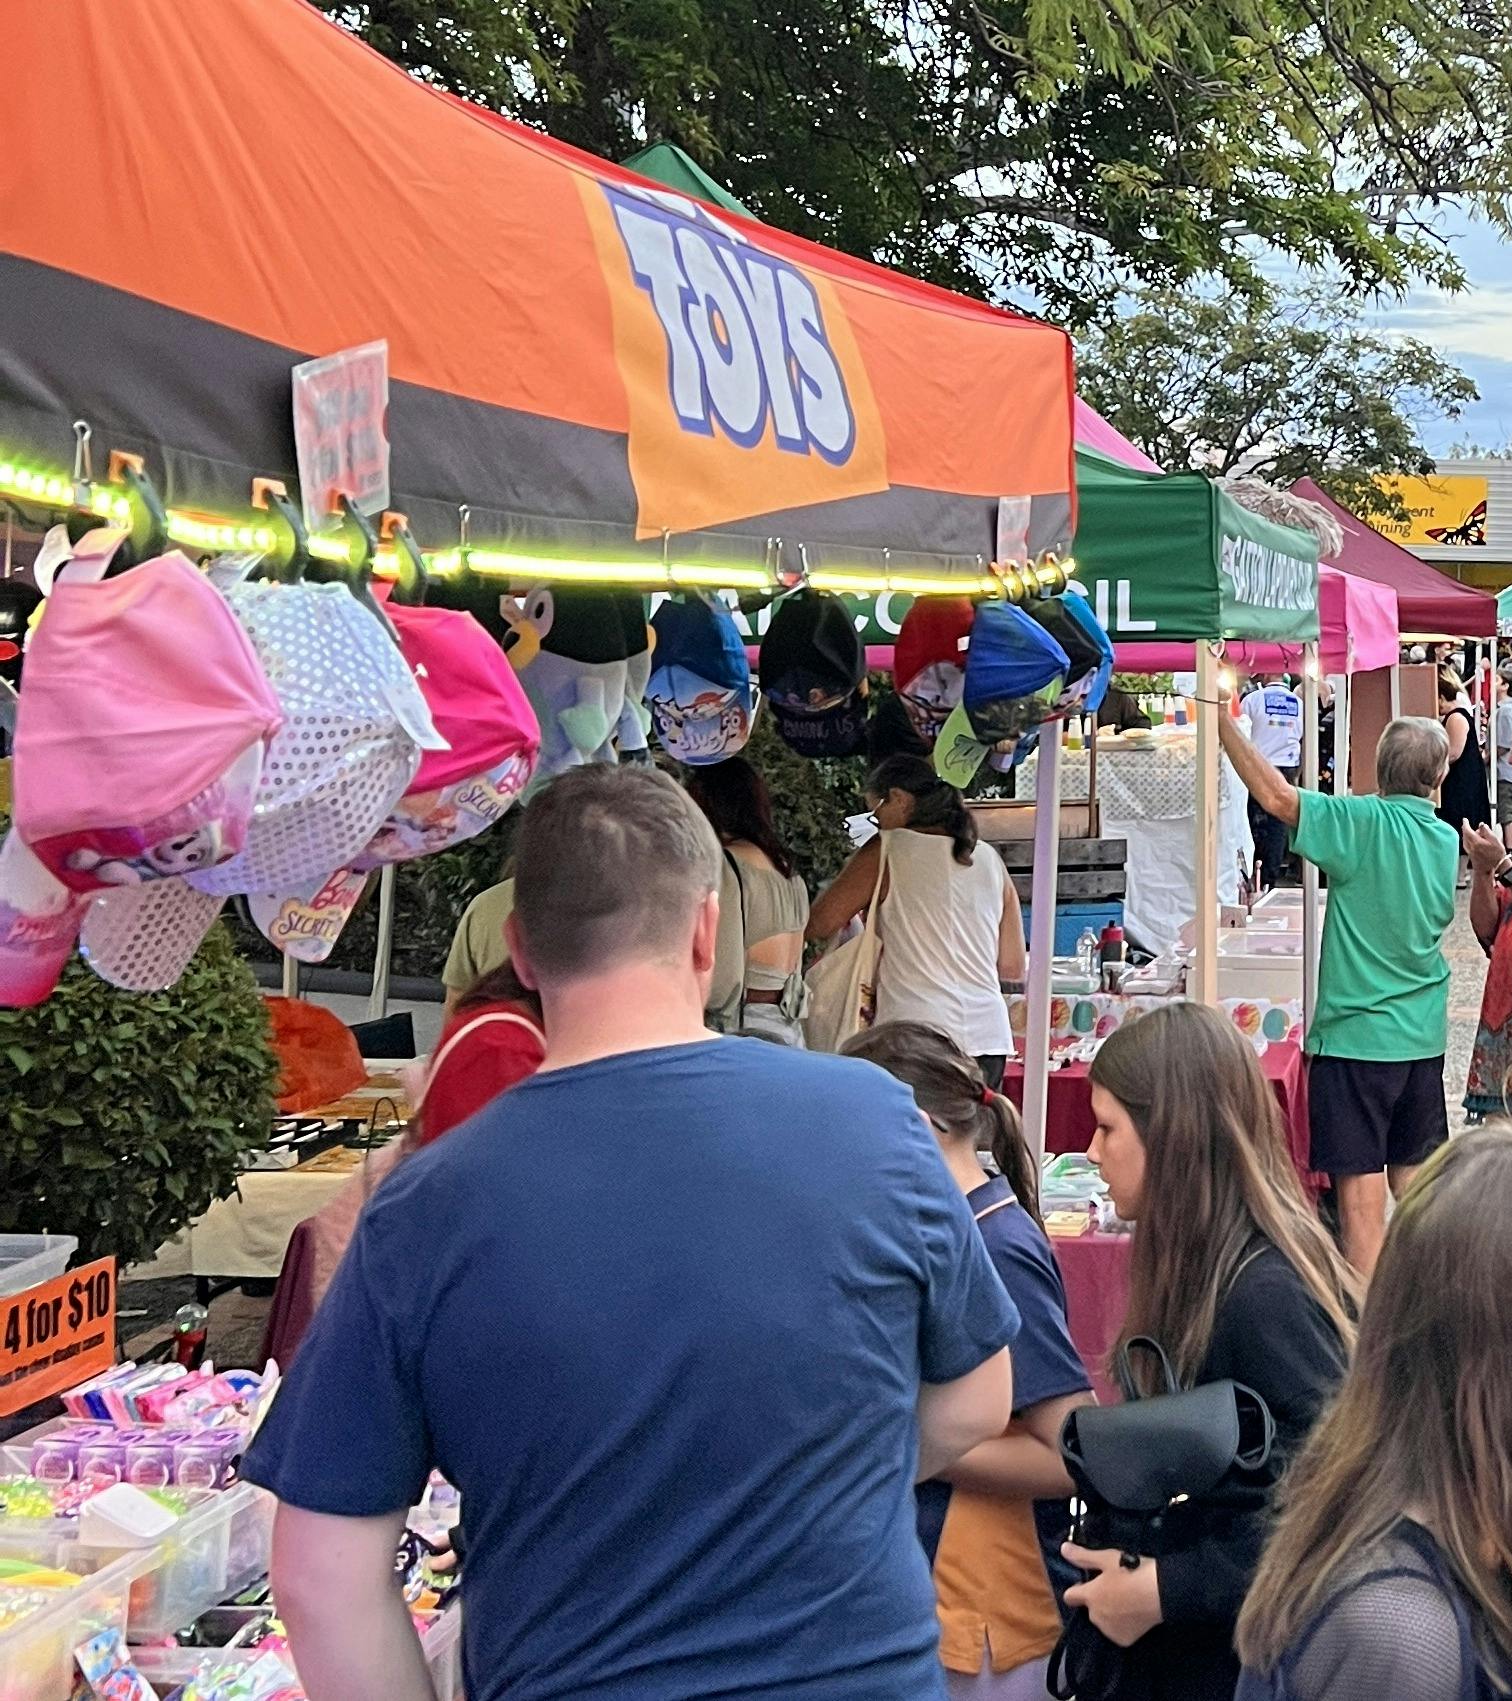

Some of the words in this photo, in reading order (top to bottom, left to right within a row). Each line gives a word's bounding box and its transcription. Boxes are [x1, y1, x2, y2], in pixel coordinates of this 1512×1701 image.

[612, 201, 854, 464] TOYS
[4, 1304, 21, 1354] 4
[27, 1298, 63, 1348] for
[68, 1270, 110, 1332] $10
